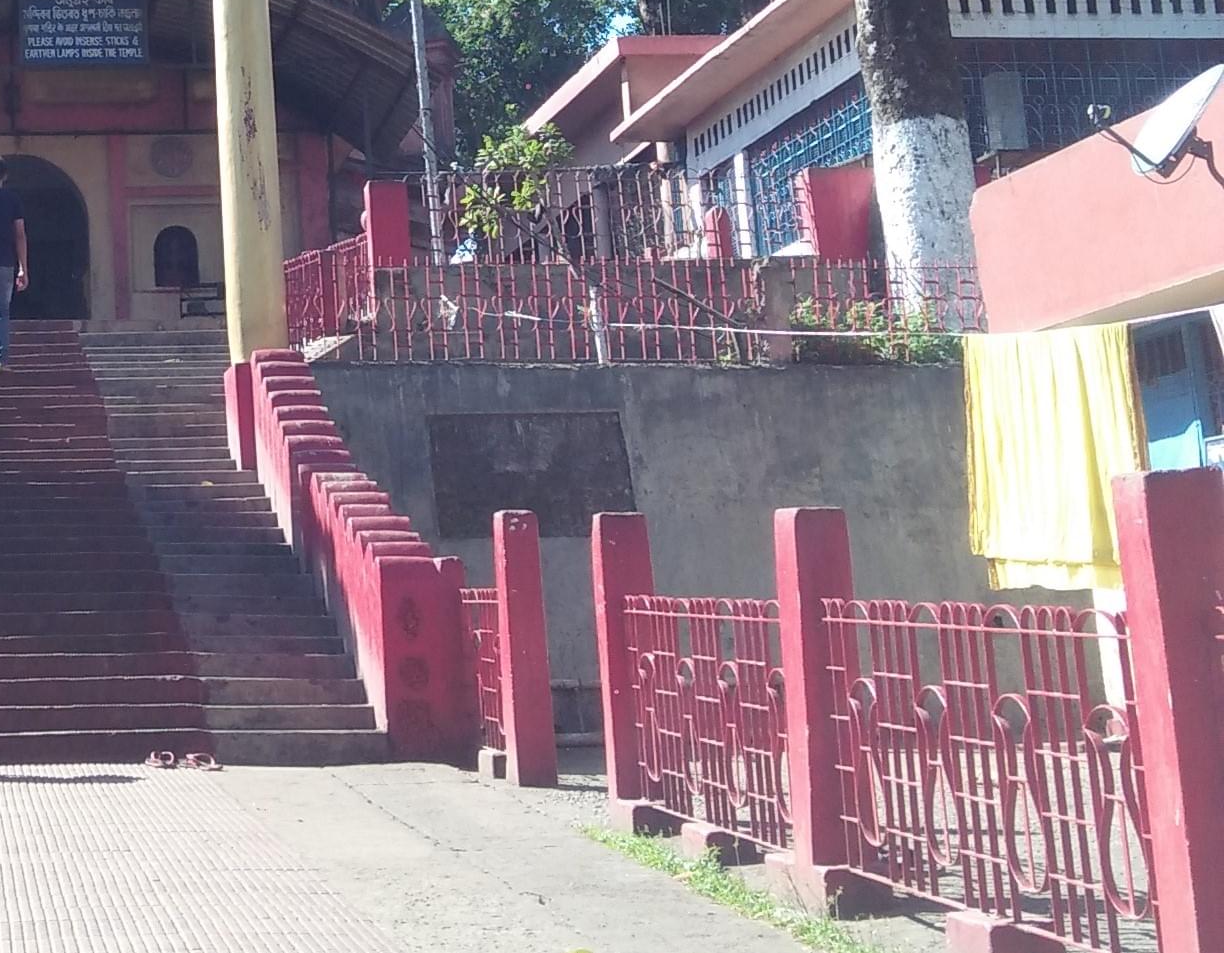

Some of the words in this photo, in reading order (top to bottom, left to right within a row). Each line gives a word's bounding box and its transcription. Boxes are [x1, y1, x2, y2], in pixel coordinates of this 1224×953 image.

[28, 36, 54, 47] PLEASE
[55, 37, 74, 47] AVOID
[106, 36, 129, 47] STICKS
[132, 36, 139, 47] &
[24, 49, 56, 60] EARTHEN
[57, 49, 80, 59] LAMPS
[81, 49, 104, 59] INSIDE
[105, 49, 117, 59] THE
[118, 49, 143, 59] TEMPLE
